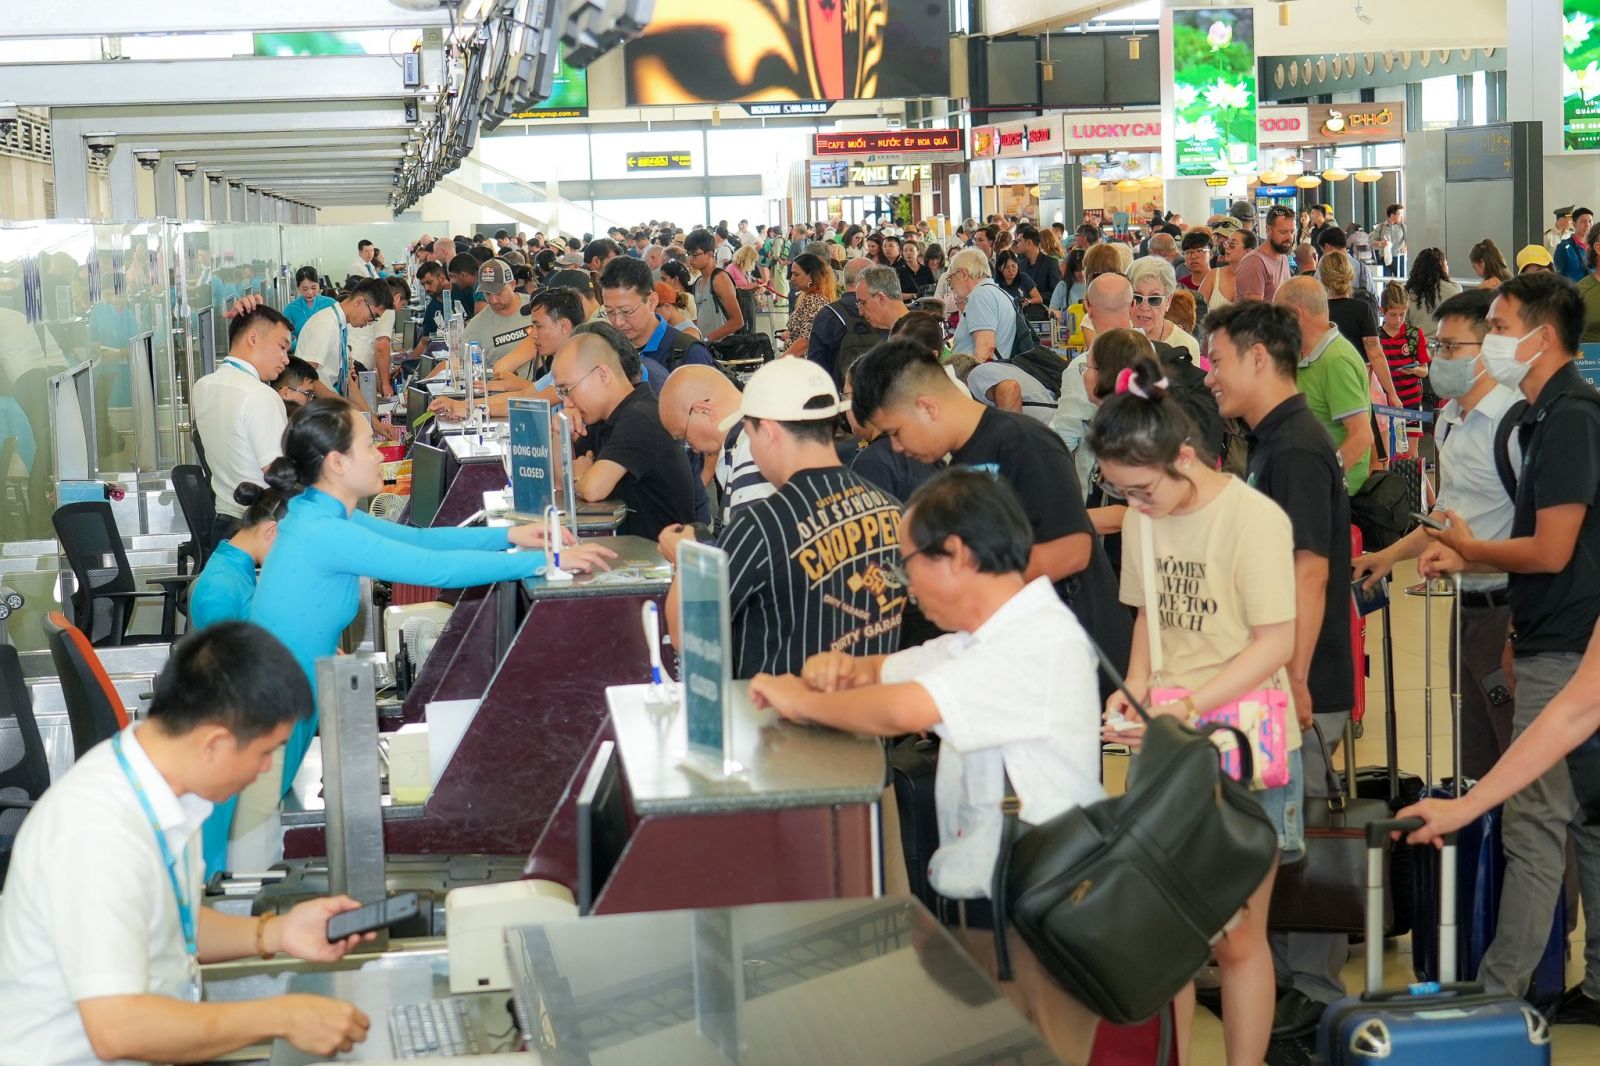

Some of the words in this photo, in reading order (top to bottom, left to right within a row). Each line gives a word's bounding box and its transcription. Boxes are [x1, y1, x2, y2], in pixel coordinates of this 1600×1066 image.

[1072, 123, 1131, 139] LUCKY
[828, 141, 845, 149] CAFE
[494, 329, 527, 346] SWOOSH.
[519, 466, 545, 479] CLOSED
[797, 508, 831, 540] OLD
[1162, 576, 1199, 596] WHO
